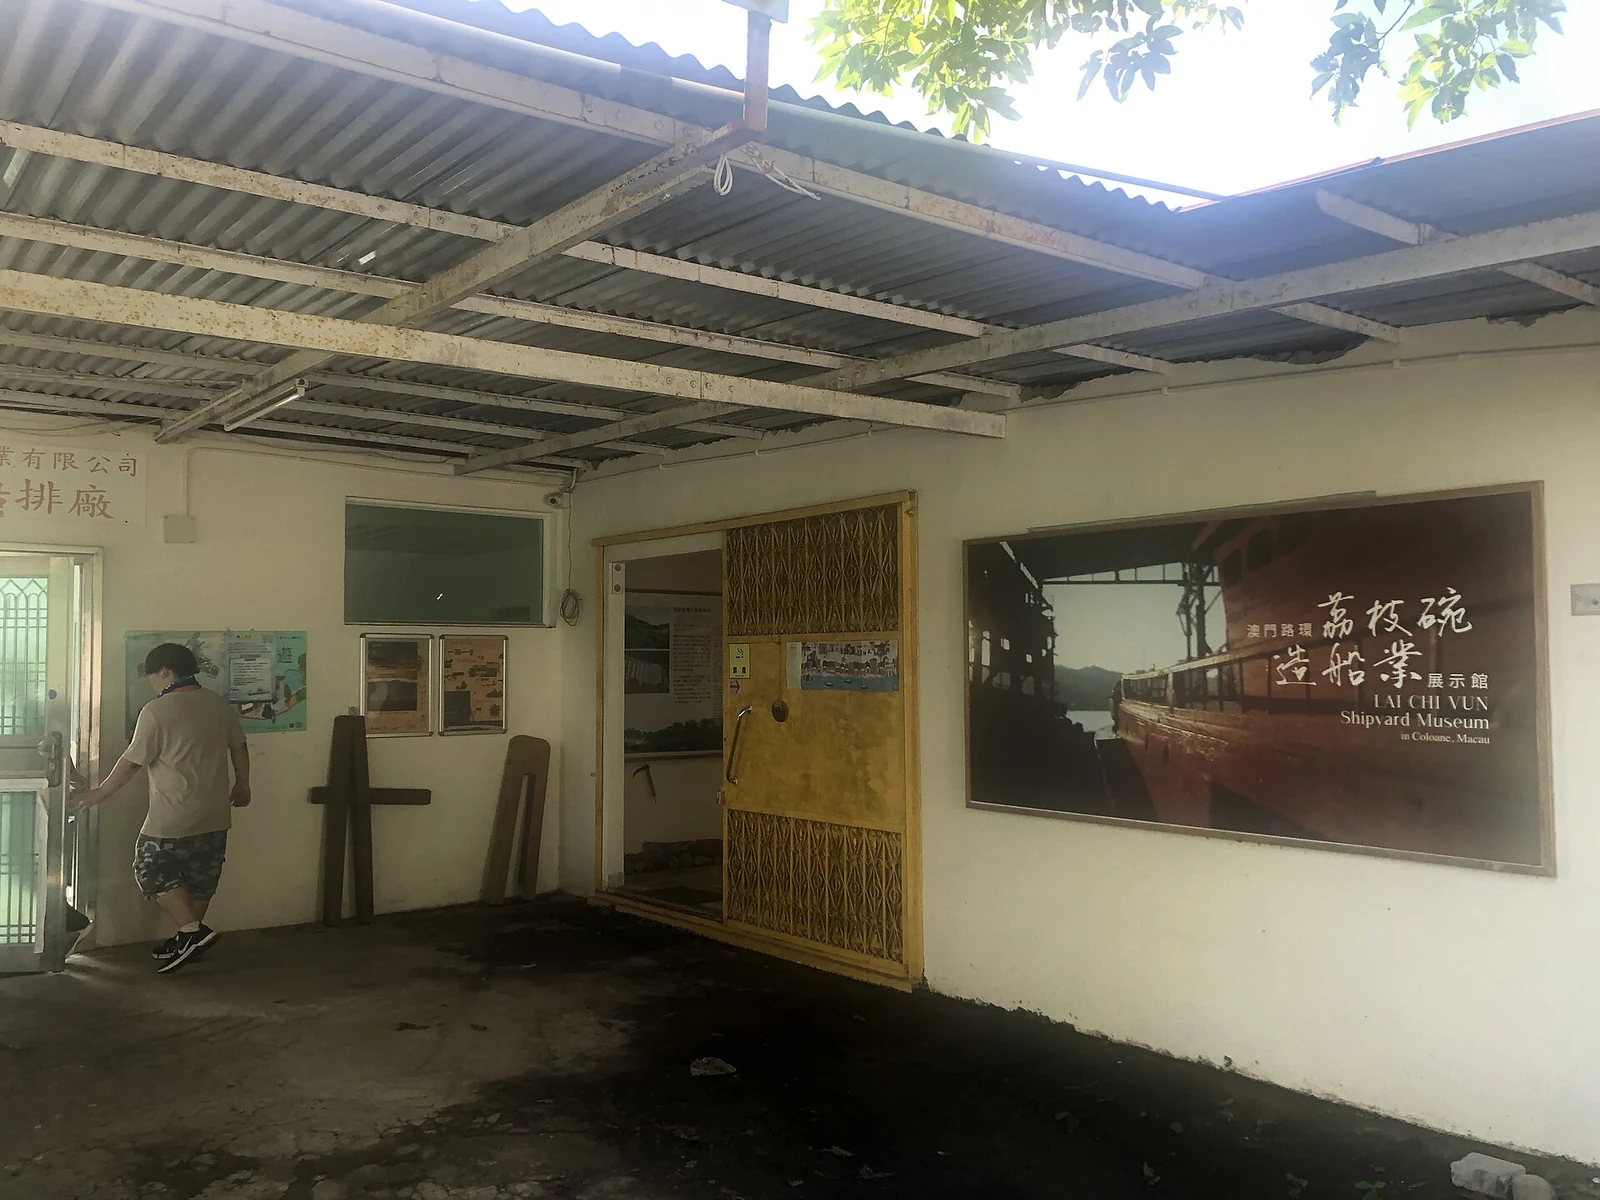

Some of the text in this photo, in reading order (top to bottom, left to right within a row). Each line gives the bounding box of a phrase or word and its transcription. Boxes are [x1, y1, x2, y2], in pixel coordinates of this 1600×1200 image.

[0, 478, 114, 519] 排廠
[1246, 587, 1473, 639] 澳門路環 荔枝碗
[1273, 639, 1488, 689] 造船業 展示館
[1374, 694, 1489, 711] LAI CHI VUN
[1340, 710, 1490, 730] Shipyard Museum
[1457, 733, 1490, 744] Macau
